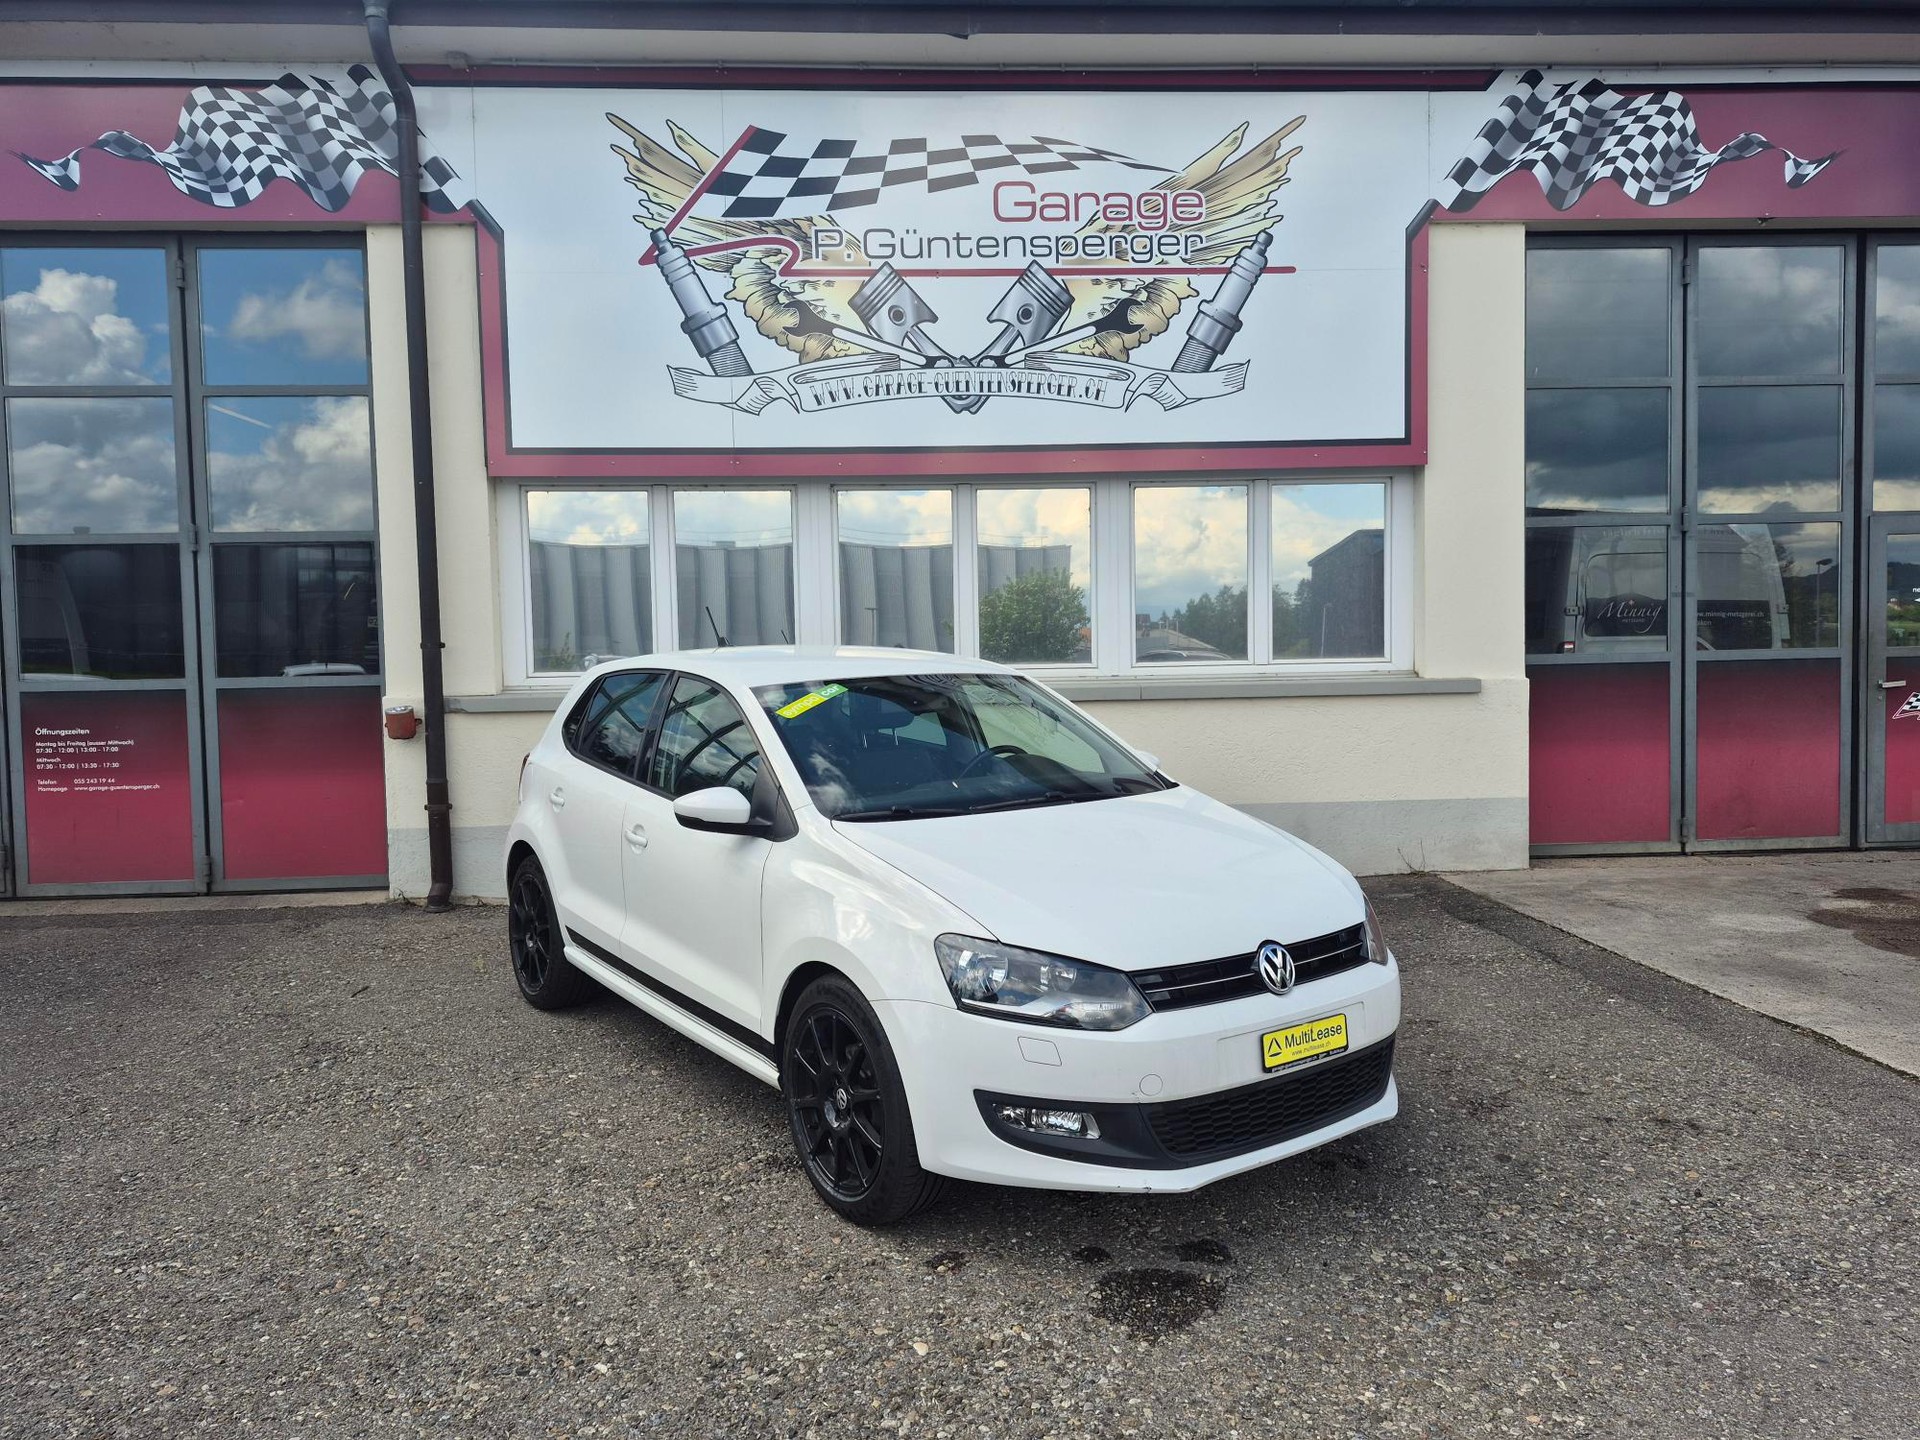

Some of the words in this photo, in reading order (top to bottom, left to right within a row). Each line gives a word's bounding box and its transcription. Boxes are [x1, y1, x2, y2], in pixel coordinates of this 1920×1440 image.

[993, 181, 1204, 231] Garage
[814, 229, 852, 259] P.
[863, 228, 1204, 264] Güntensperger
[809, 370, 1109, 406] WWW.GARAGE-GUENTENSPERGER.CH
[1597, 599, 1662, 633] Minnig
[821, 685, 841, 697] car
[35, 727, 90, 737] Öffnungszeiten
[1284, 1023, 1343, 1050] MultiLease
